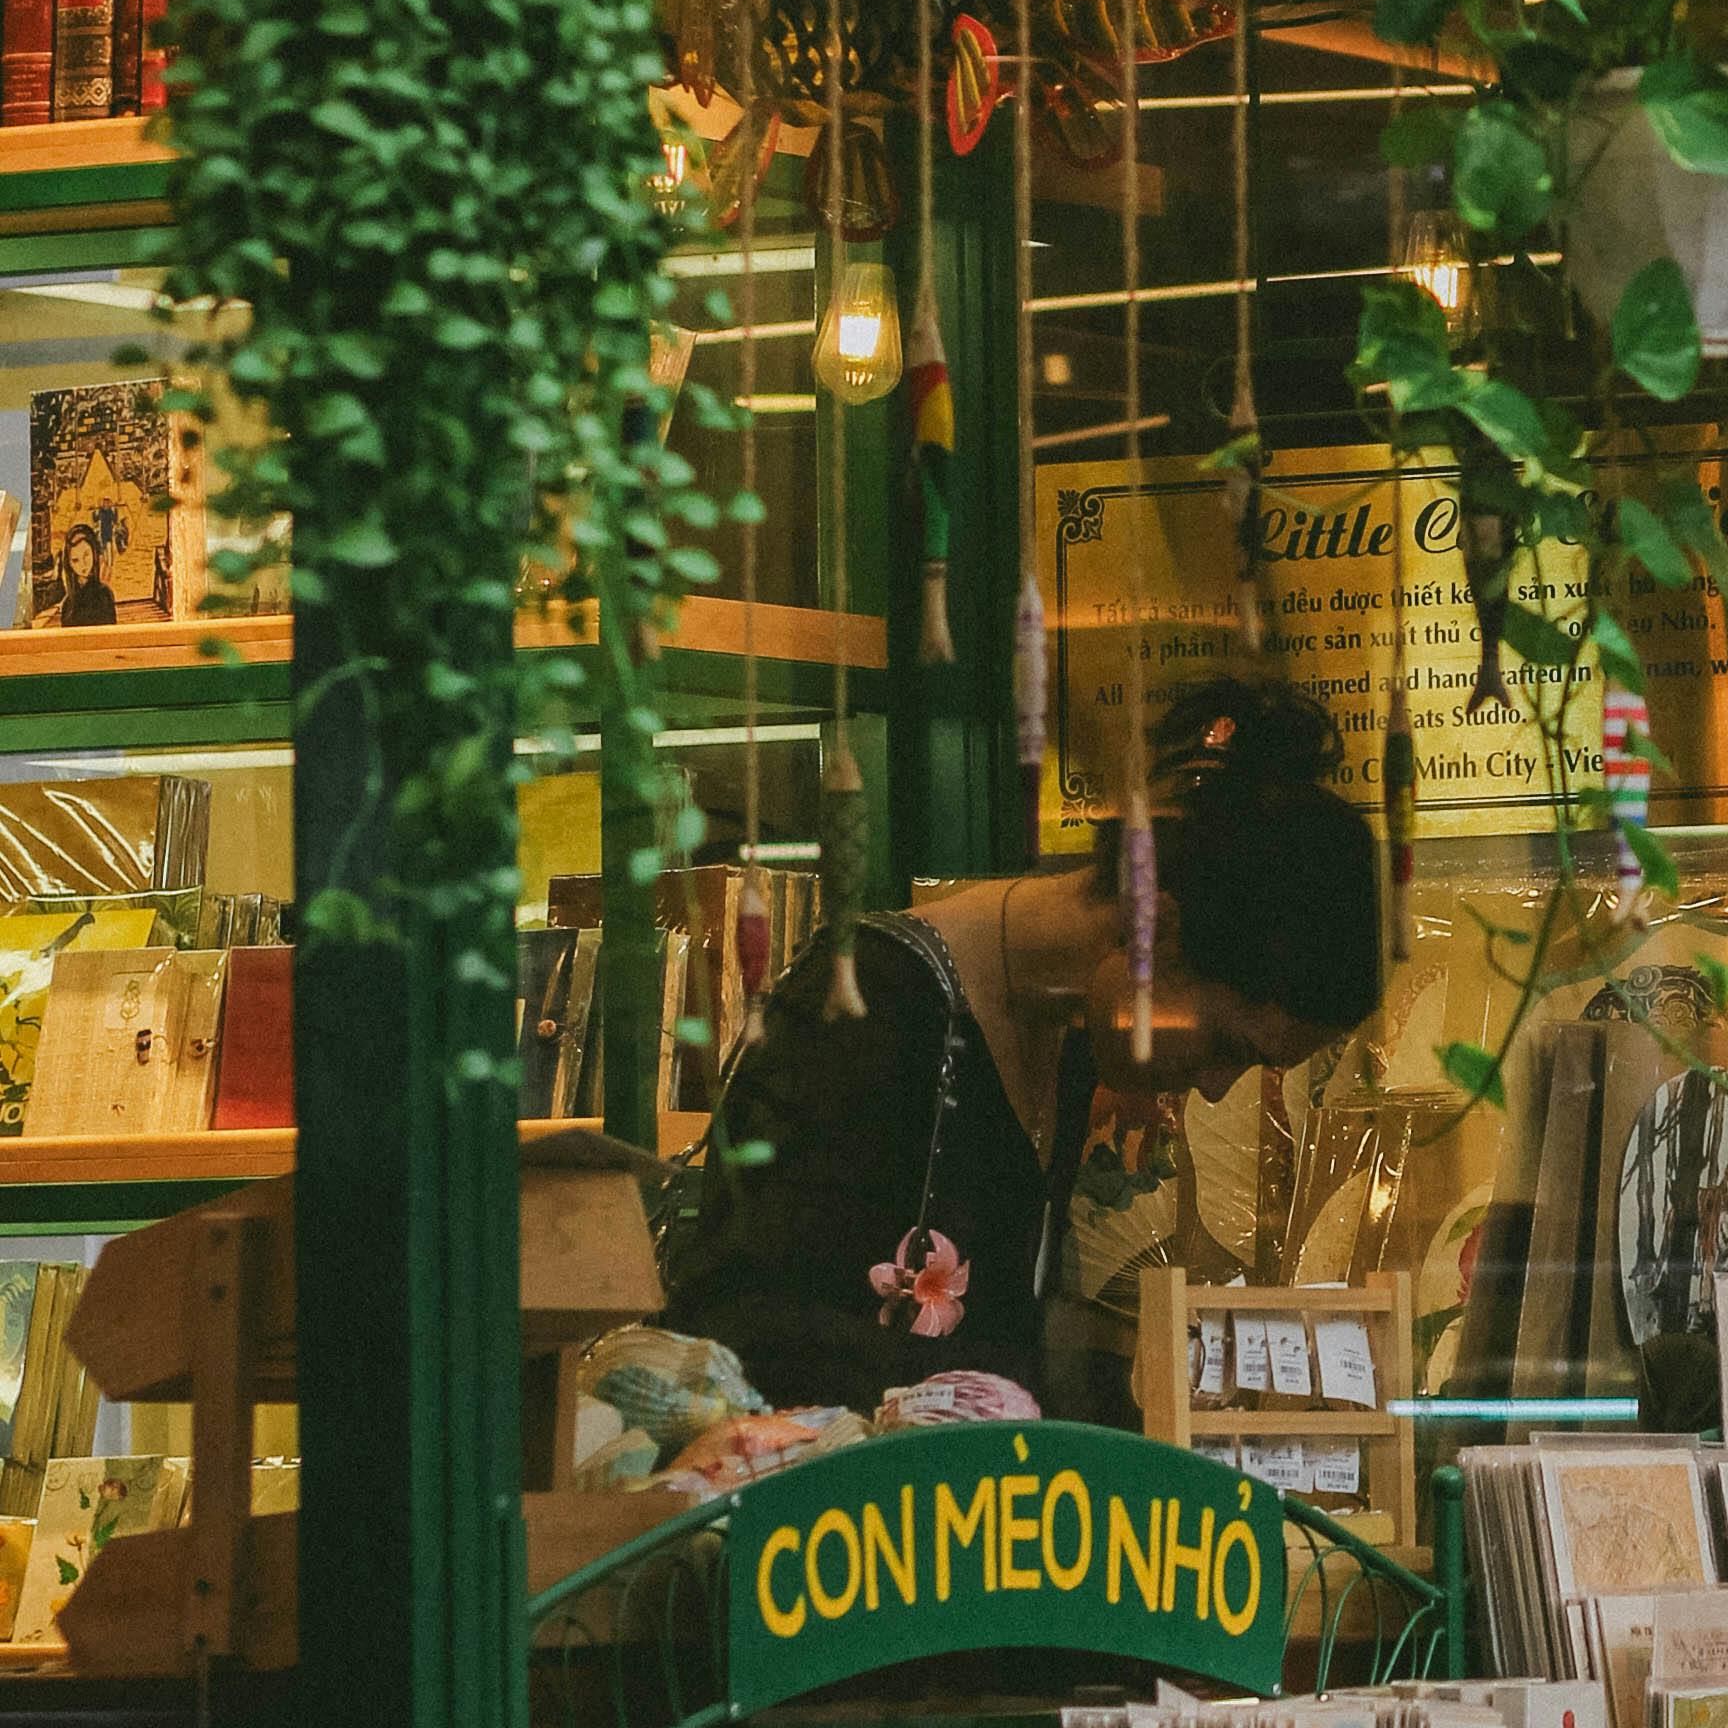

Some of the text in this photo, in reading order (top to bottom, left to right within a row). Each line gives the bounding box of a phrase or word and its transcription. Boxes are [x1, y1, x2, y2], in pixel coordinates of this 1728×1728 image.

[1259, 503, 1394, 562] Little
[1323, 625, 1361, 651] sản
[1425, 620, 1461, 646] thủ
[1405, 706, 1446, 731] ats
[1413, 753, 1477, 782] Minh
[1485, 750, 1537, 785] City
[757, 1434, 1261, 1638] CON MÈO NHỎ
